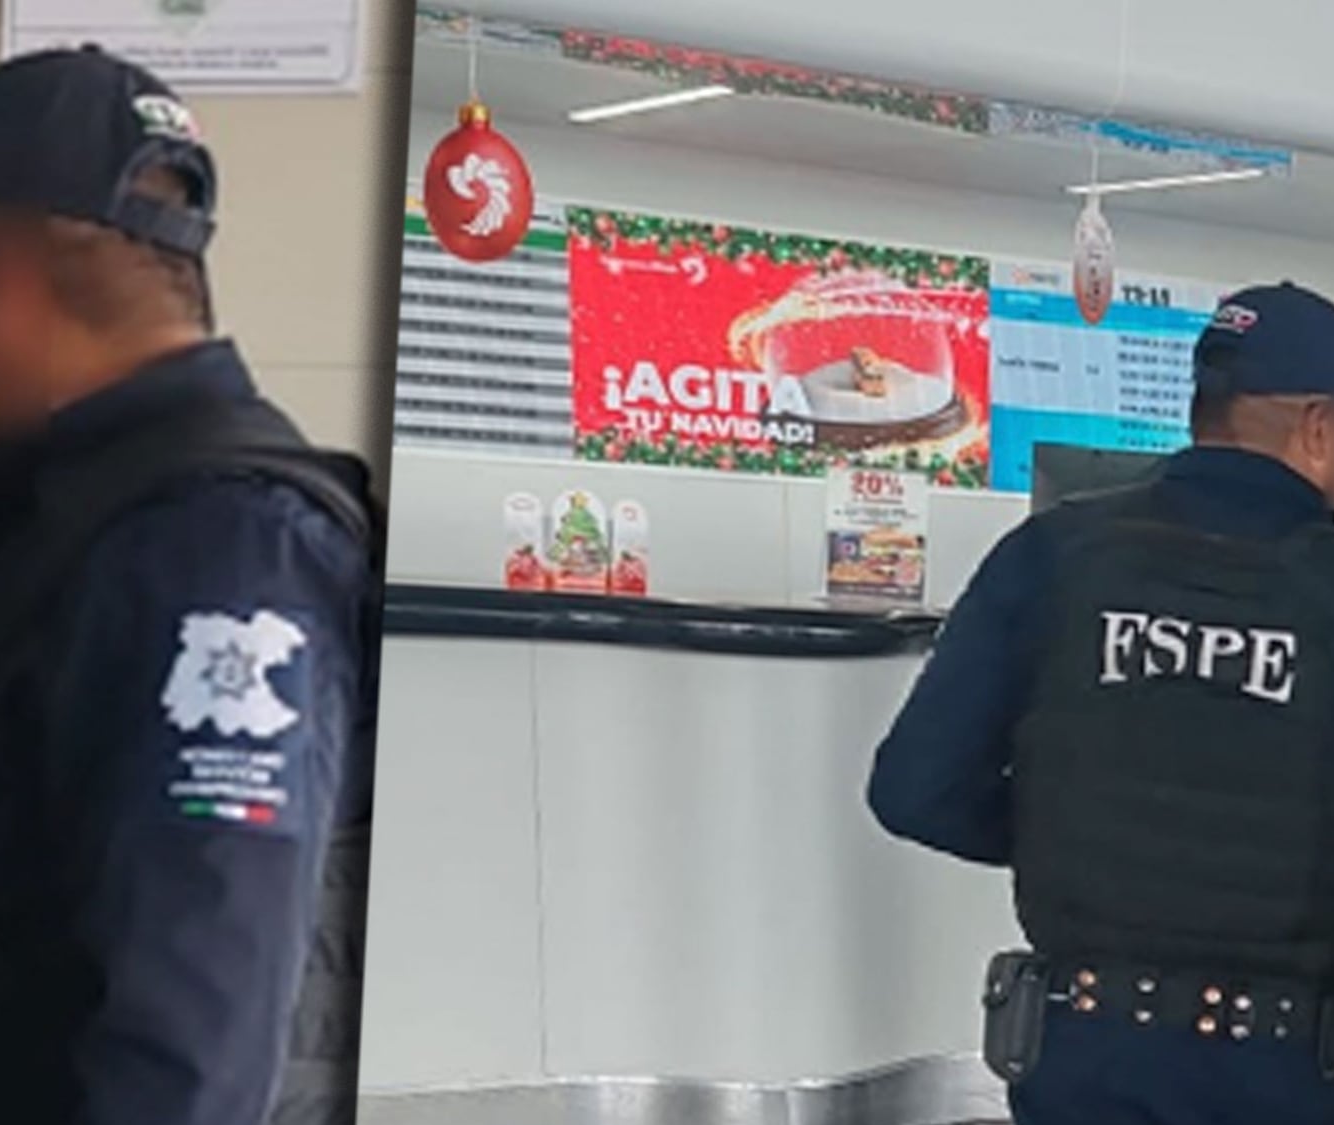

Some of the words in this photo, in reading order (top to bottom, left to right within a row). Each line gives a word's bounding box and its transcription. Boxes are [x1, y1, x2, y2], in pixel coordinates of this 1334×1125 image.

[603, 361, 813, 416] ¡AGITA
[670, 413, 816, 443] NAVIDAD!
[1099, 611, 1296, 704] FSPE
